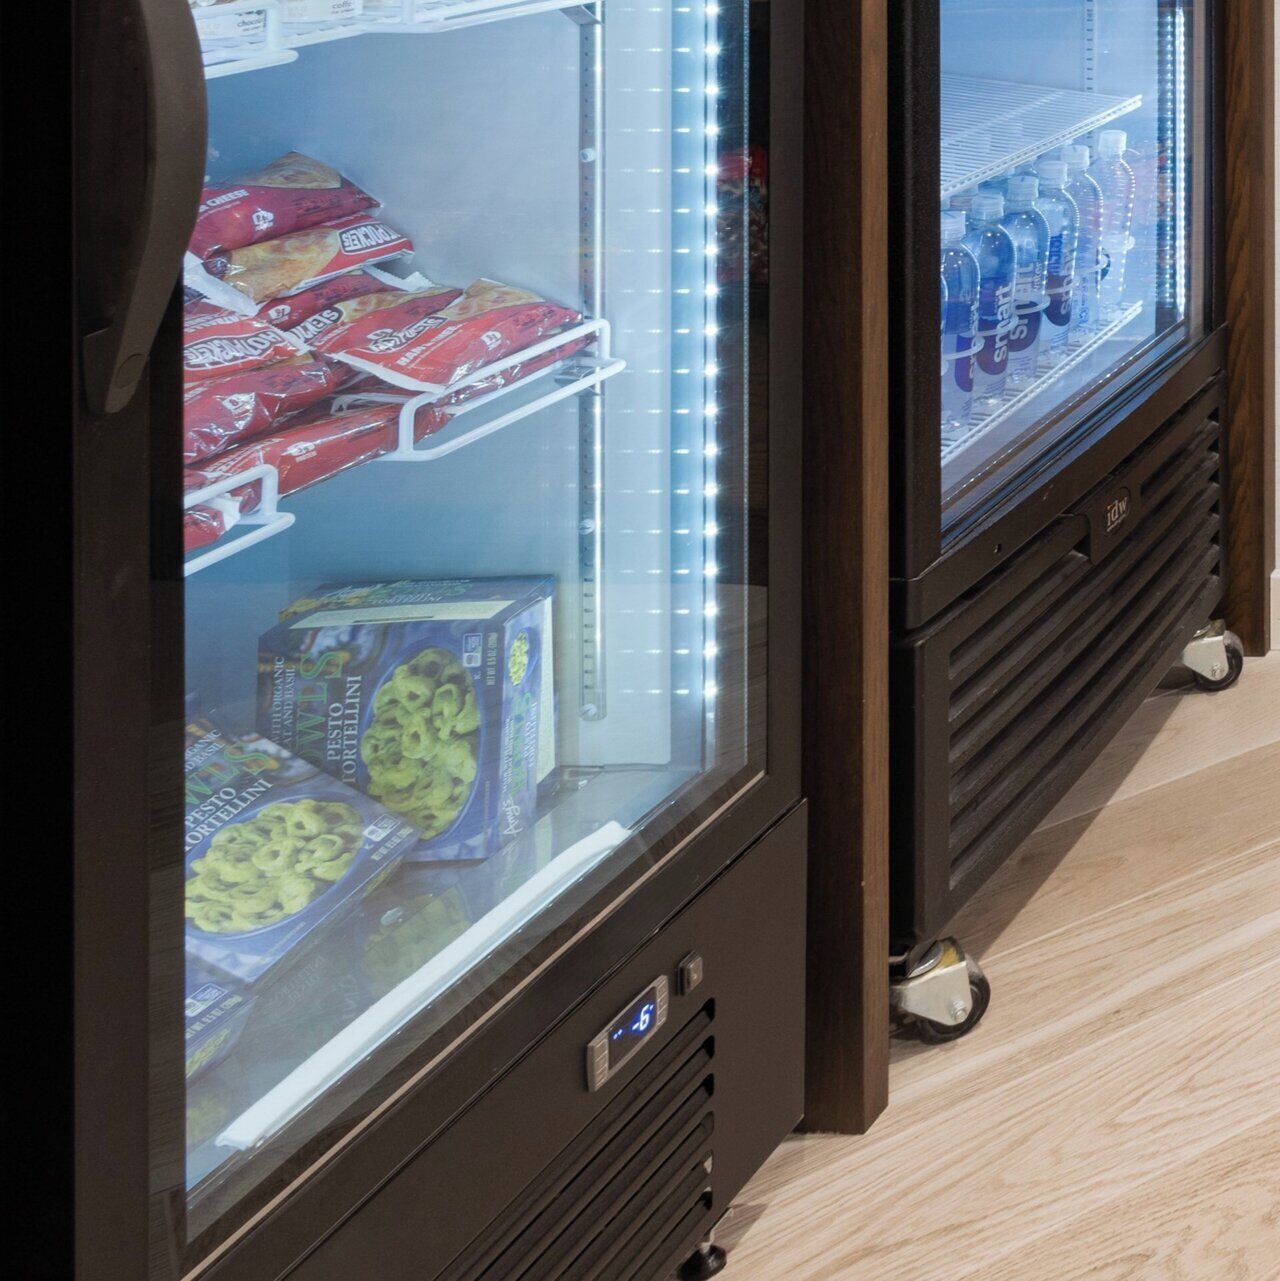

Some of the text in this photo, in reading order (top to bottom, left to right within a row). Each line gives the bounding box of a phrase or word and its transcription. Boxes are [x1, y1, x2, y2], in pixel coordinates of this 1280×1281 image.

[210, 188, 249, 206] CHEESE
[327, 702, 344, 761] PESTO
[341, 674, 362, 785] TORTELLINI
[184, 778, 274, 851] ORTELLINI
